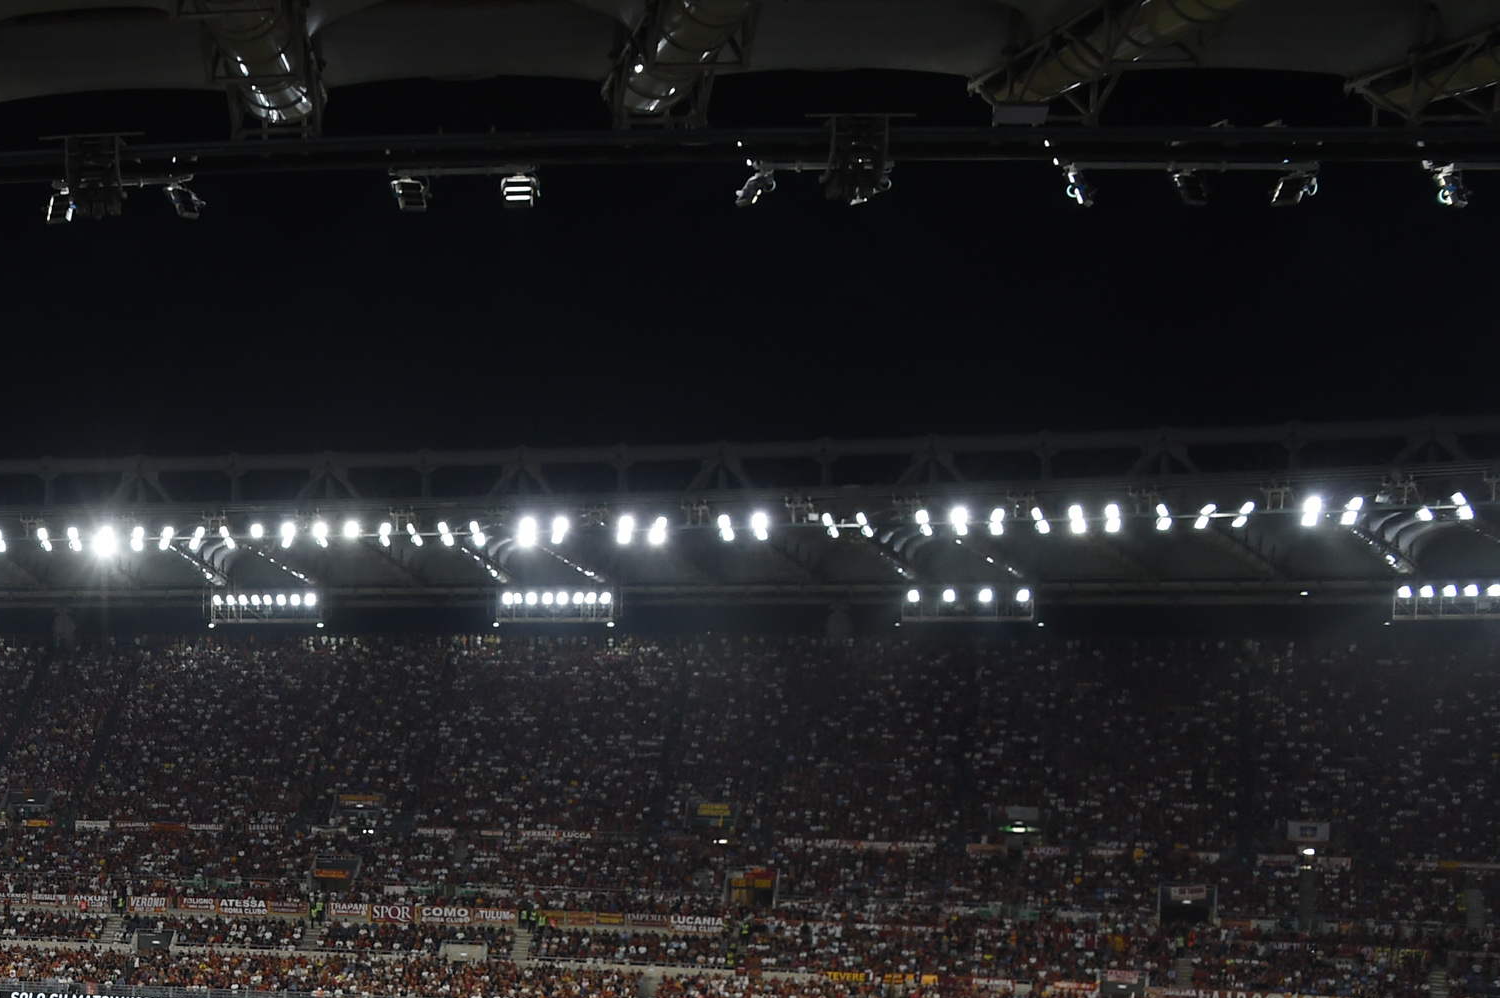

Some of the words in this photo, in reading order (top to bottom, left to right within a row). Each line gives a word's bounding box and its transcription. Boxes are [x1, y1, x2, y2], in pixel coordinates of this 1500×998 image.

[563, 831, 591, 839] LUCCA
[73, 894, 108, 902] ANXUR
[130, 896, 166, 907] VERONA
[183, 897, 214, 905] FOLIGNO
[220, 898, 266, 908] ATESSA
[332, 903, 368, 911] TRAPANI
[421, 907, 469, 917] COMO
[373, 905, 412, 922] SPQR
[670, 915, 723, 926] LUCANIA
